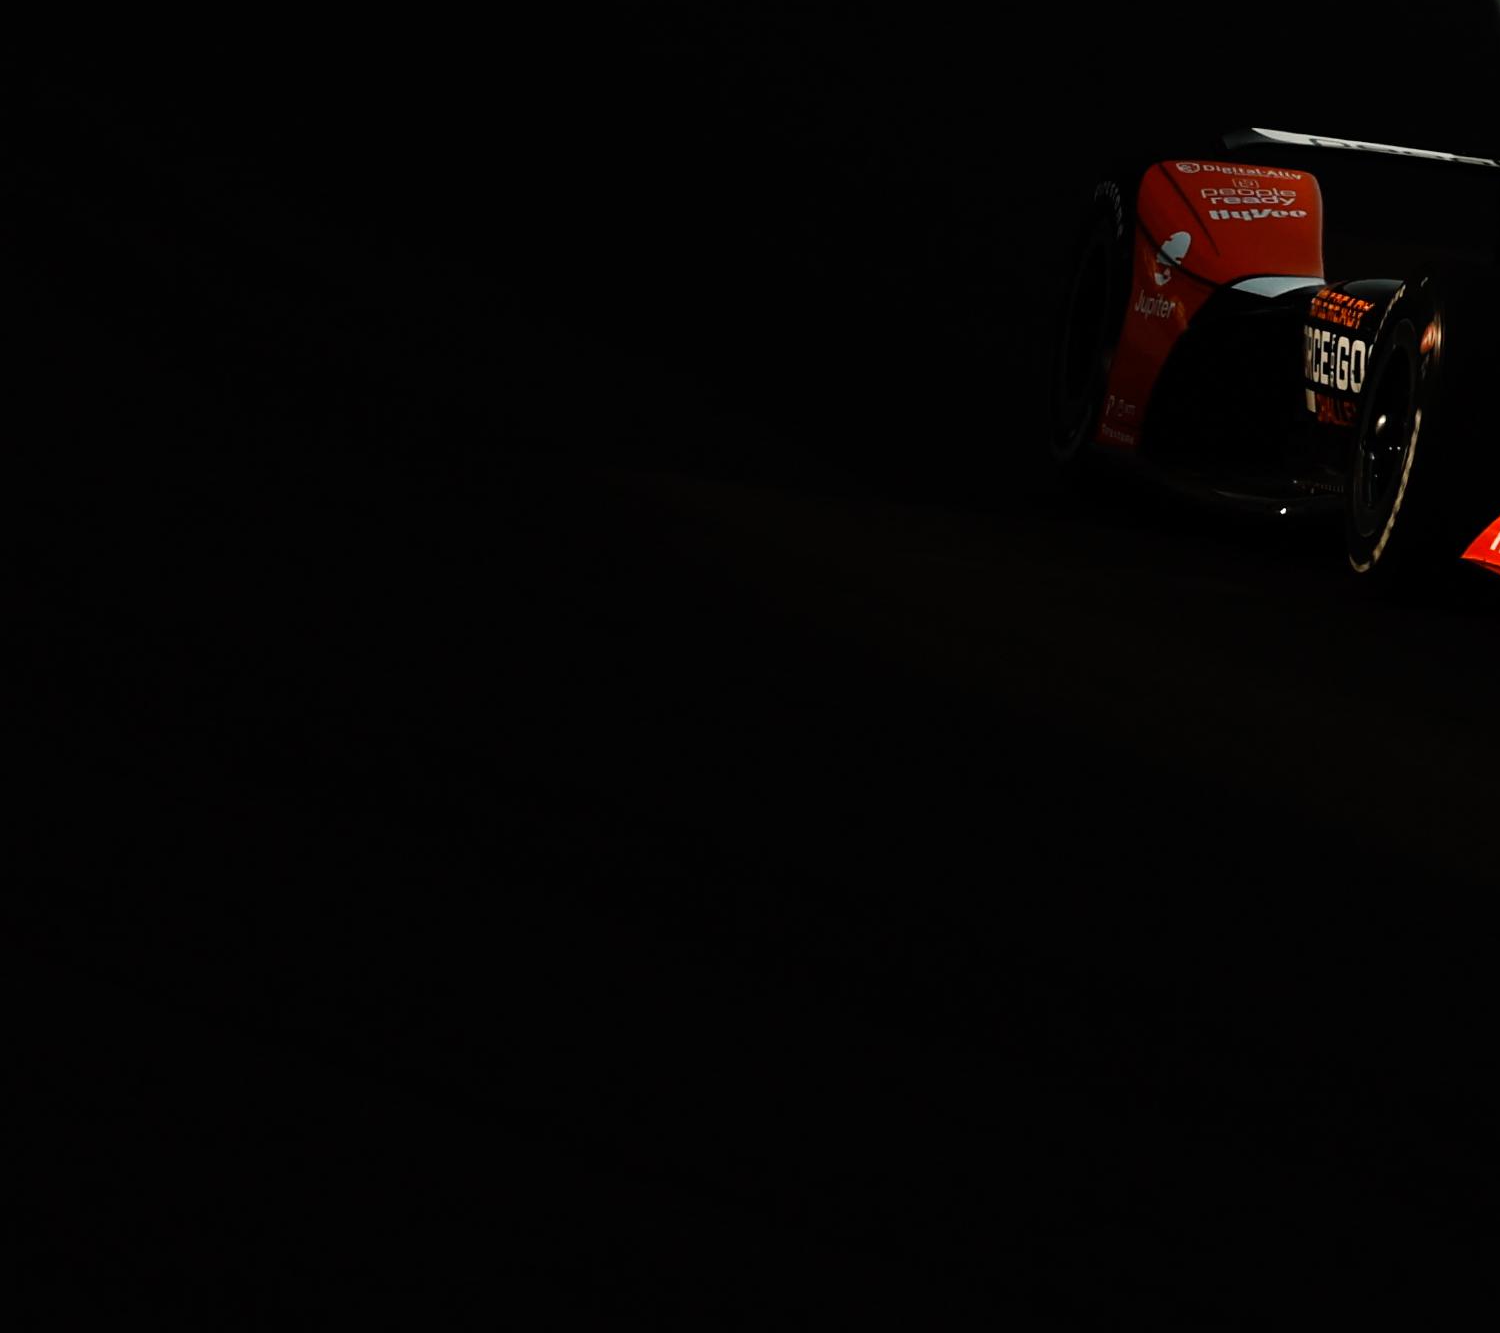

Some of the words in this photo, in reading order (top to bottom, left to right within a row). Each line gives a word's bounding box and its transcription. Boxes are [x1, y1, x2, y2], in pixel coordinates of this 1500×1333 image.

[1200, 188, 1297, 199] people
[1210, 196, 1296, 206] ready
[1135, 289, 1176, 320] Jupiter
